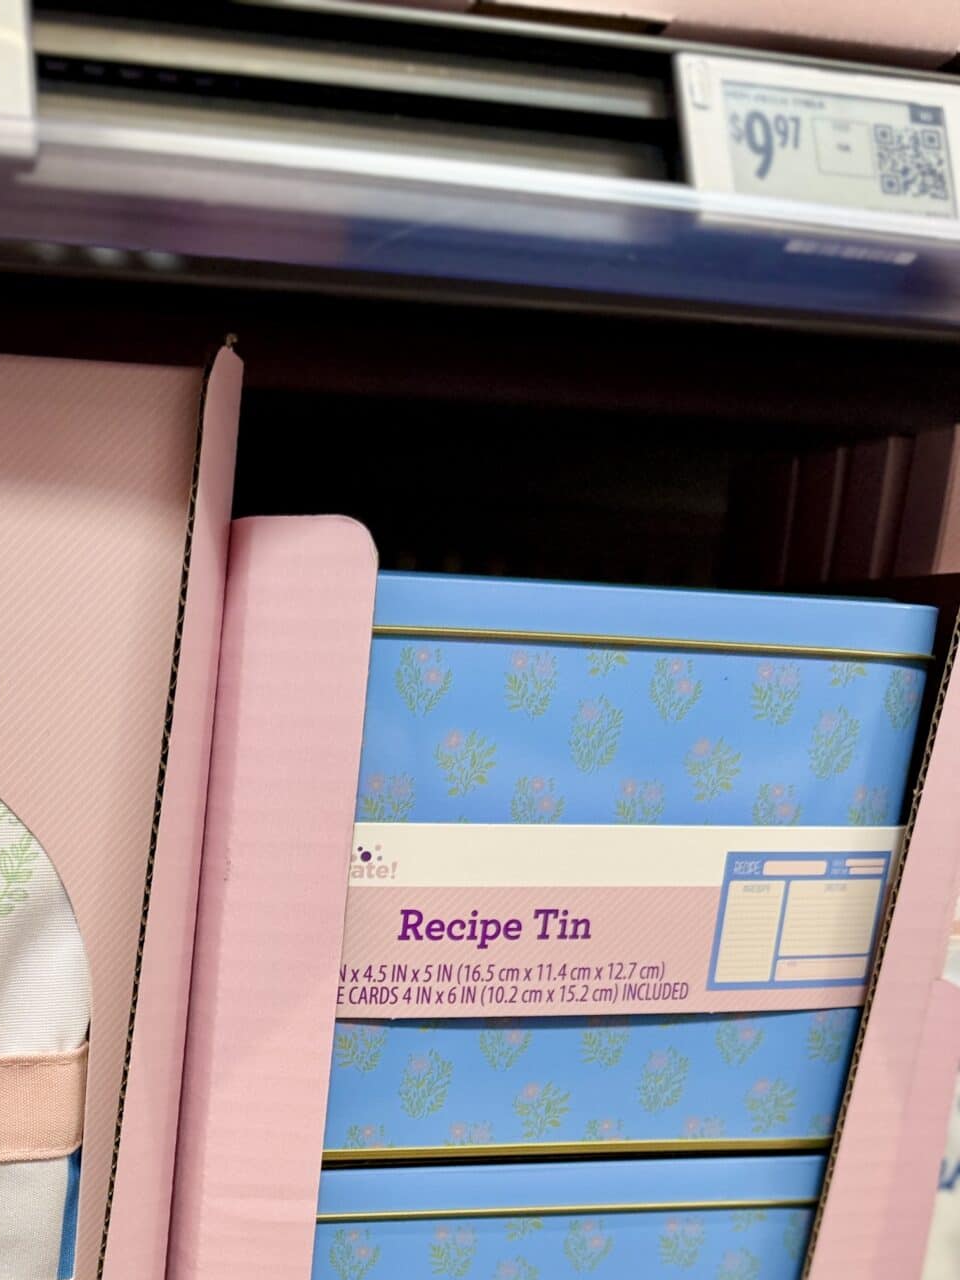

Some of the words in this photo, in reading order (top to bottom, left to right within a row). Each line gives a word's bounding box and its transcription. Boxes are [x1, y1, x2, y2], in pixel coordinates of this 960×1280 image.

[397, 908, 523, 950] Recipe
[533, 908, 592, 940] Tin
[350, 968, 359, 983] x
[363, 964, 388, 983] 4.5
[391, 964, 408, 983] IN
[411, 968, 420, 982] x
[423, 964, 433, 982] 5
[436, 963, 453, 982] IN
[456, 963, 496, 984] (16.5
[498, 966, 520, 982] cm
[523, 967, 533, 981] x
[537, 963, 568, 981] 11.4
[570, 967, 591, 981] cm
[594, 966, 604, 981] x
[607, 962, 638, 980] 12.7
[640, 961, 666, 981] cm)
[349, 986, 399, 1005] CARDS
[402, 986, 412, 1004] 4
[416, 986, 432, 1004] IN
[434, 990, 444, 1004] x
[447, 986, 457, 1004] 6
[460, 986, 477, 1004] IN
[480, 985, 518, 1007] (10.2
[521, 988, 542, 1003] cm
[545, 988, 555, 1003] x
[559, 985, 589, 1003] 15.2
[592, 984, 618, 1004] cm)
[622, 982, 690, 1001] INCLUDED
